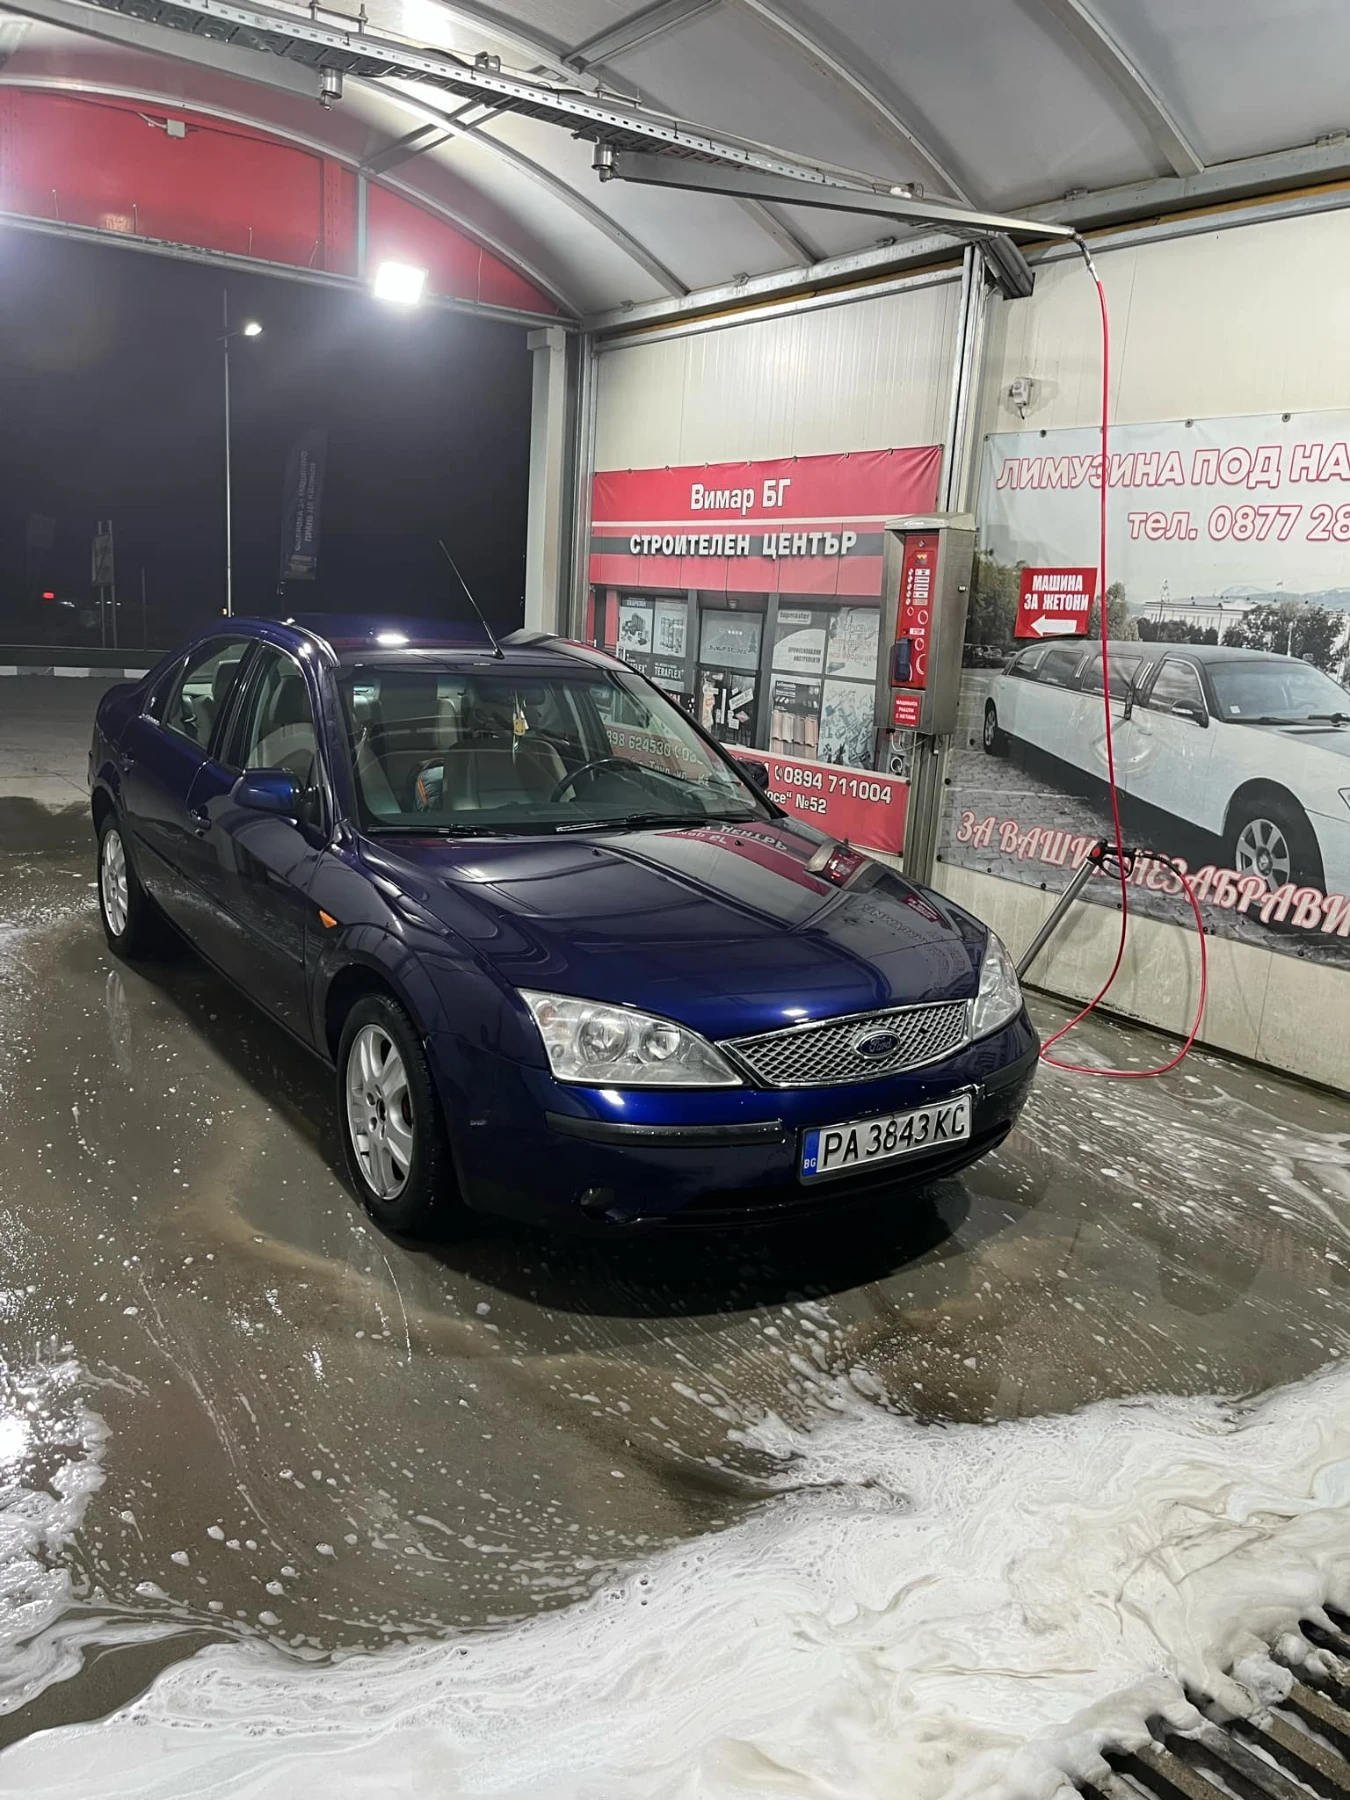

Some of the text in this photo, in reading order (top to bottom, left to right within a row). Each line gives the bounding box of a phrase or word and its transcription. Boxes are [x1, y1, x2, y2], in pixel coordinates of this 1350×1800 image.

[996, 442, 1350, 490] ЛИМУЗИНА ПОД НА
[690, 478, 791, 516] Вимар БГ
[1128, 503, 1350, 542] тел. 0877 28
[630, 531, 858, 560] СТРОИТЕЛЕН ЦЕНТЪР
[1032, 574, 1083, 592] МАШИНА
[1024, 593, 1090, 611] ЗА ЖЕТОНИ
[628, 735, 671, 757] 624530
[784, 767, 823, 790] 0894
[828, 774, 892, 804] 711004
[795, 793, 828, 814] №52
[956, 809, 997, 849] ЗА
[869, 1036, 892, 1053] Ford
[823, 1104, 965, 1166] PA 3843 KC
[803, 1158, 816, 1169] BG
